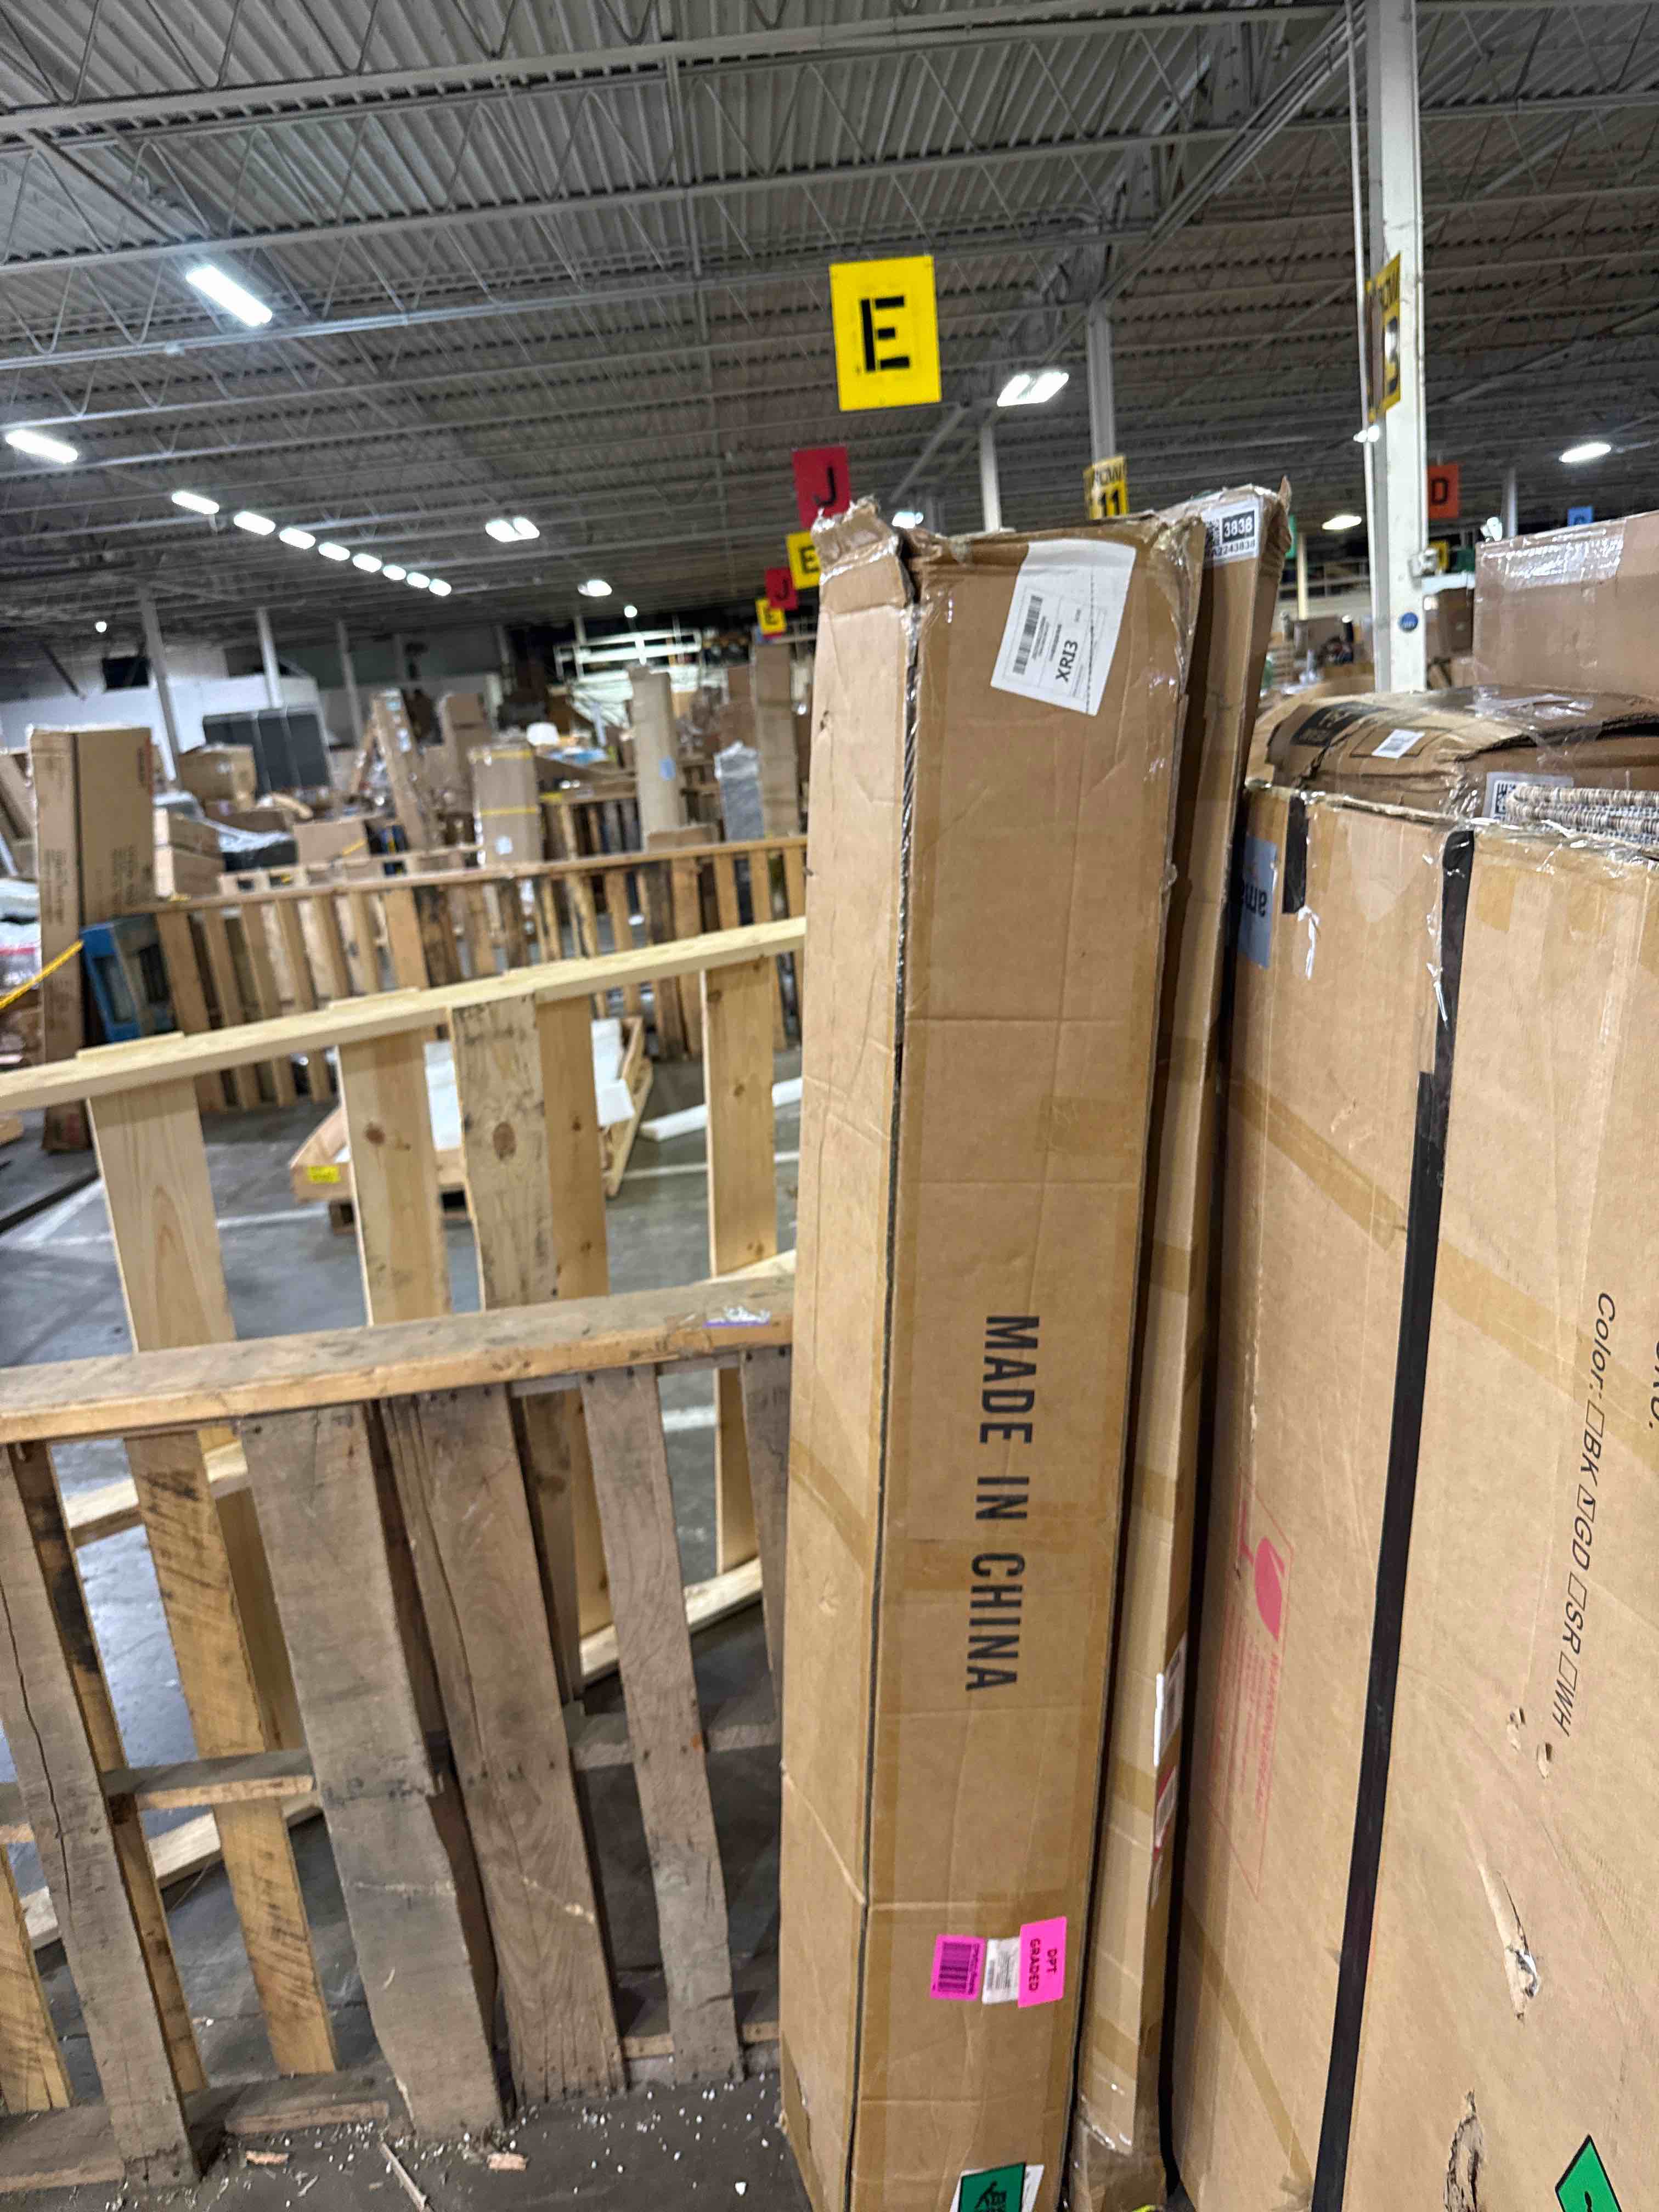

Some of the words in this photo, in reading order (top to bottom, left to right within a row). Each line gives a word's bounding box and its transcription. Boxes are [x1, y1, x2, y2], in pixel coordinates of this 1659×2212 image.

[860, 295, 910, 373] E
[813, 466, 836, 507] J
[1431, 477, 1449, 505] D
[1224, 516, 1253, 538] 3838
[799, 545, 820, 574] E
[1055, 640, 1078, 682] XRI3
[1589, 1293, 1615, 1400] Color:
[979, 1316, 1040, 1444] MADE
[1581, 1429, 1601, 1487] BK
[975, 1476, 1030, 1520] IN
[1572, 1516, 1593, 1571] GD
[965, 1552, 1026, 1691] CHINA
[1562, 1601, 1583, 1655] SR
[1552, 1678, 1575, 1737] WH
[1029, 1938, 1041, 1991] GRADED
